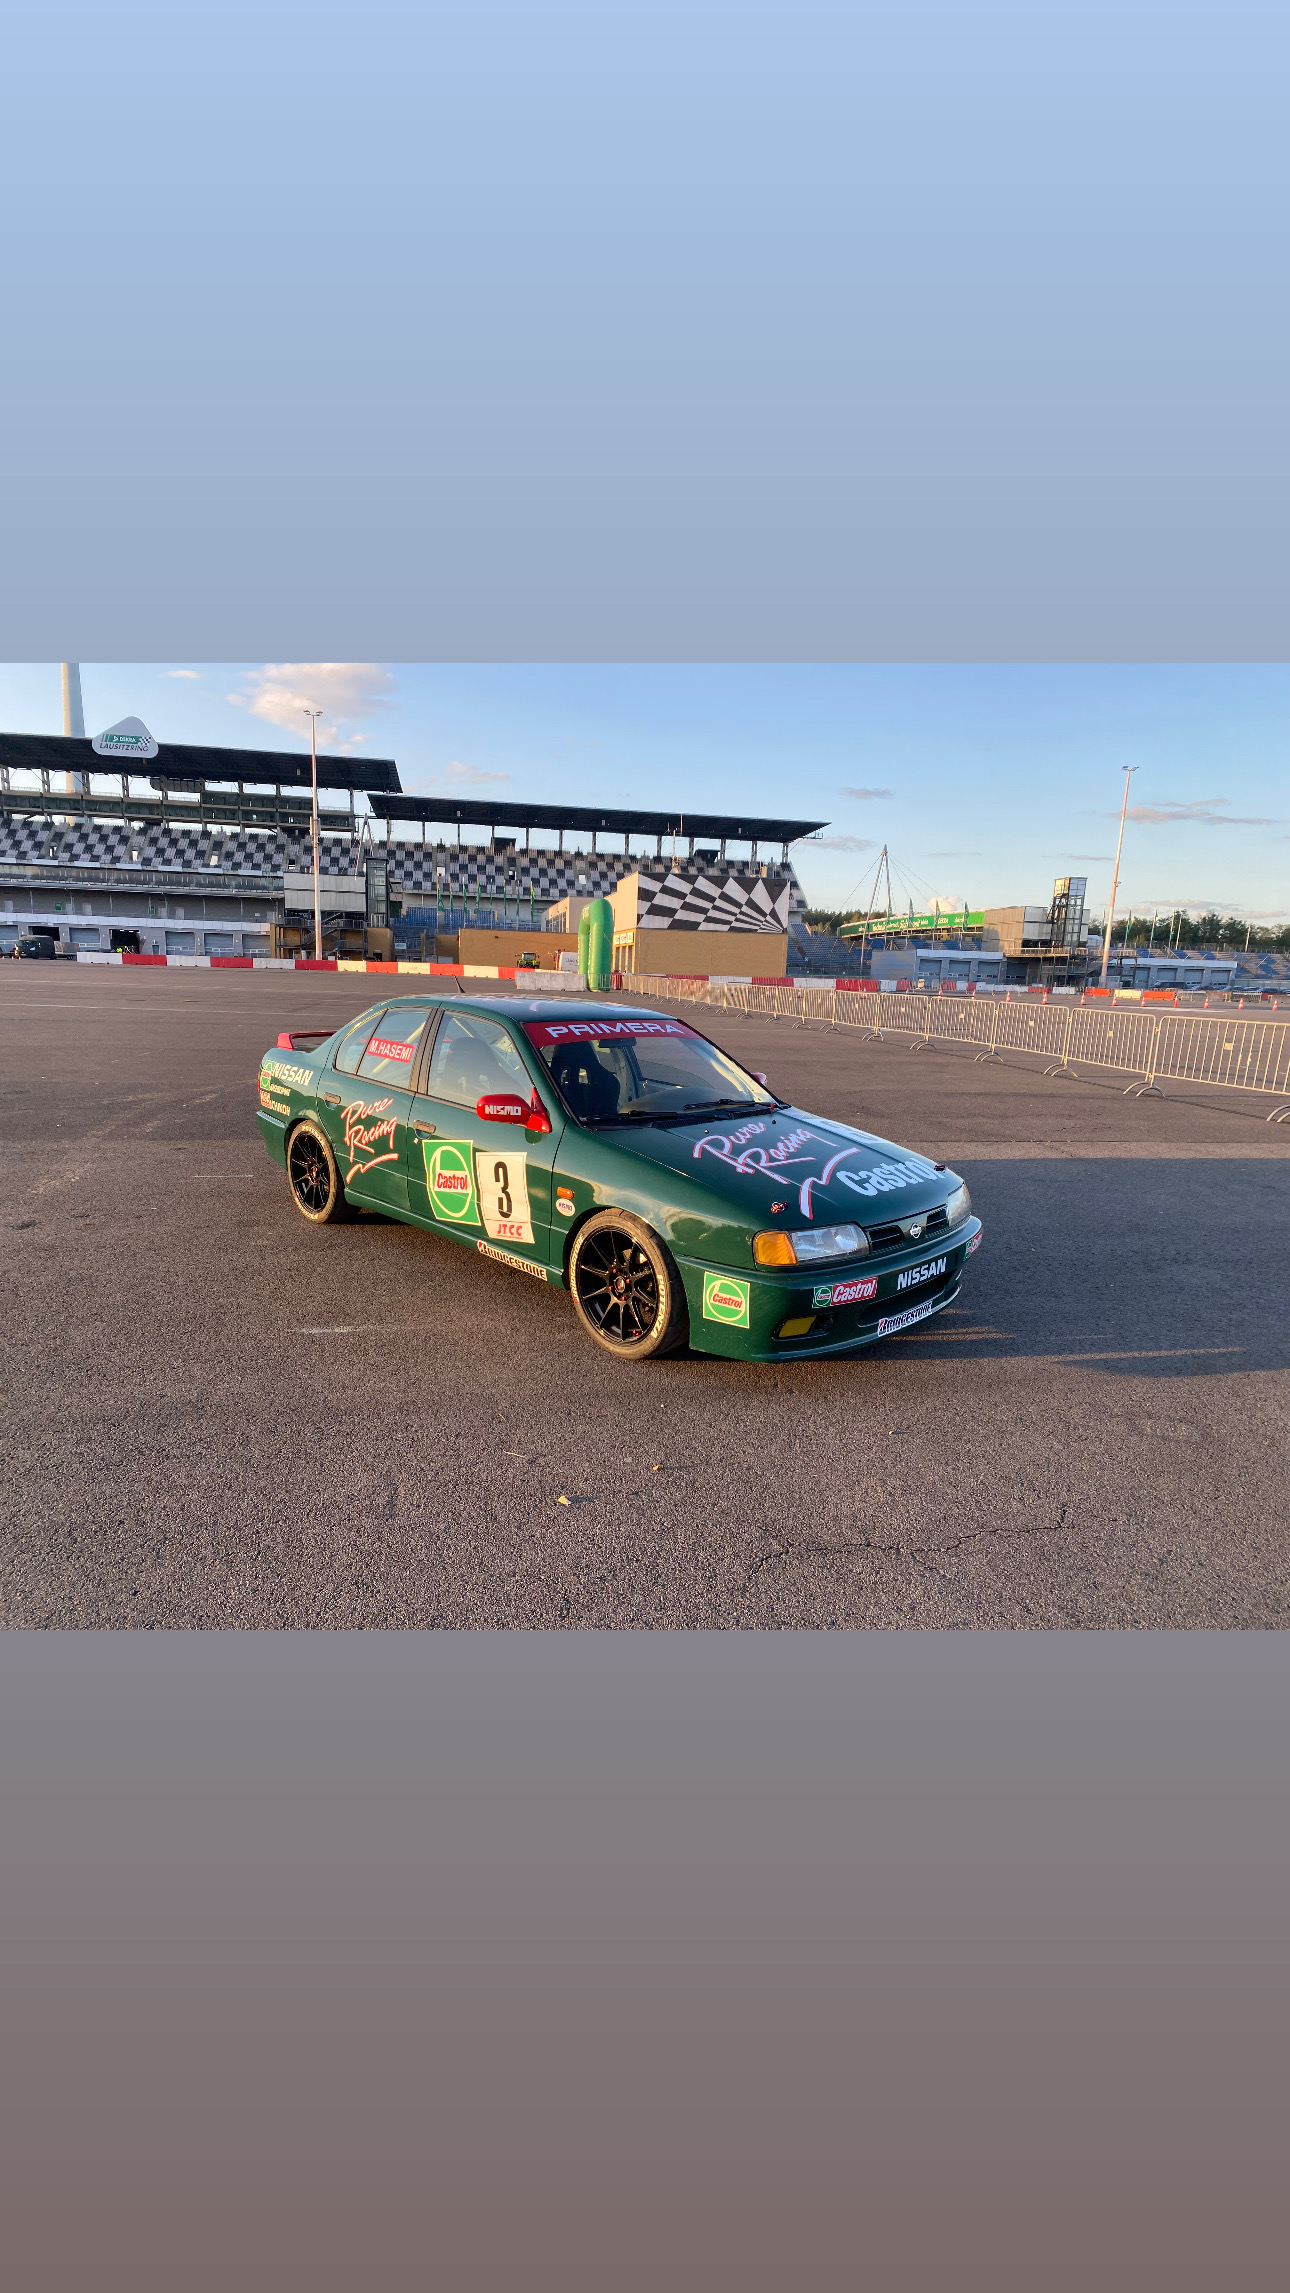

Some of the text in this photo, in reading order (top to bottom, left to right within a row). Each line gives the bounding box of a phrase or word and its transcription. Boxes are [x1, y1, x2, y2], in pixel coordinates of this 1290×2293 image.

[99, 743, 149, 752] LAUSITZRING
[545, 1022, 685, 1038] PRIMERA
[369, 1040, 413, 1061] M.HASEMI
[272, 1061, 314, 1087] NISSAN
[341, 1098, 394, 1146] Pure
[484, 1104, 522, 1116] NISMO
[346, 1116, 398, 1162] Racing
[693, 1121, 767, 1174] Pure
[736, 1128, 840, 1185] Racing
[436, 1172, 468, 1191] Castrol
[493, 1160, 513, 1219] 3
[836, 1157, 946, 1197] Castrol
[496, 1223, 523, 1237] JTCC
[478, 1241, 547, 1280] BRIDGESTONE
[896, 1256, 946, 1291] NISSAN
[650, 1274, 666, 1338] POTENZA
[712, 1292, 743, 1309] Castrol
[832, 1279, 877, 1303] Castrol
[878, 1302, 933, 1336] BRIDGESTONE
